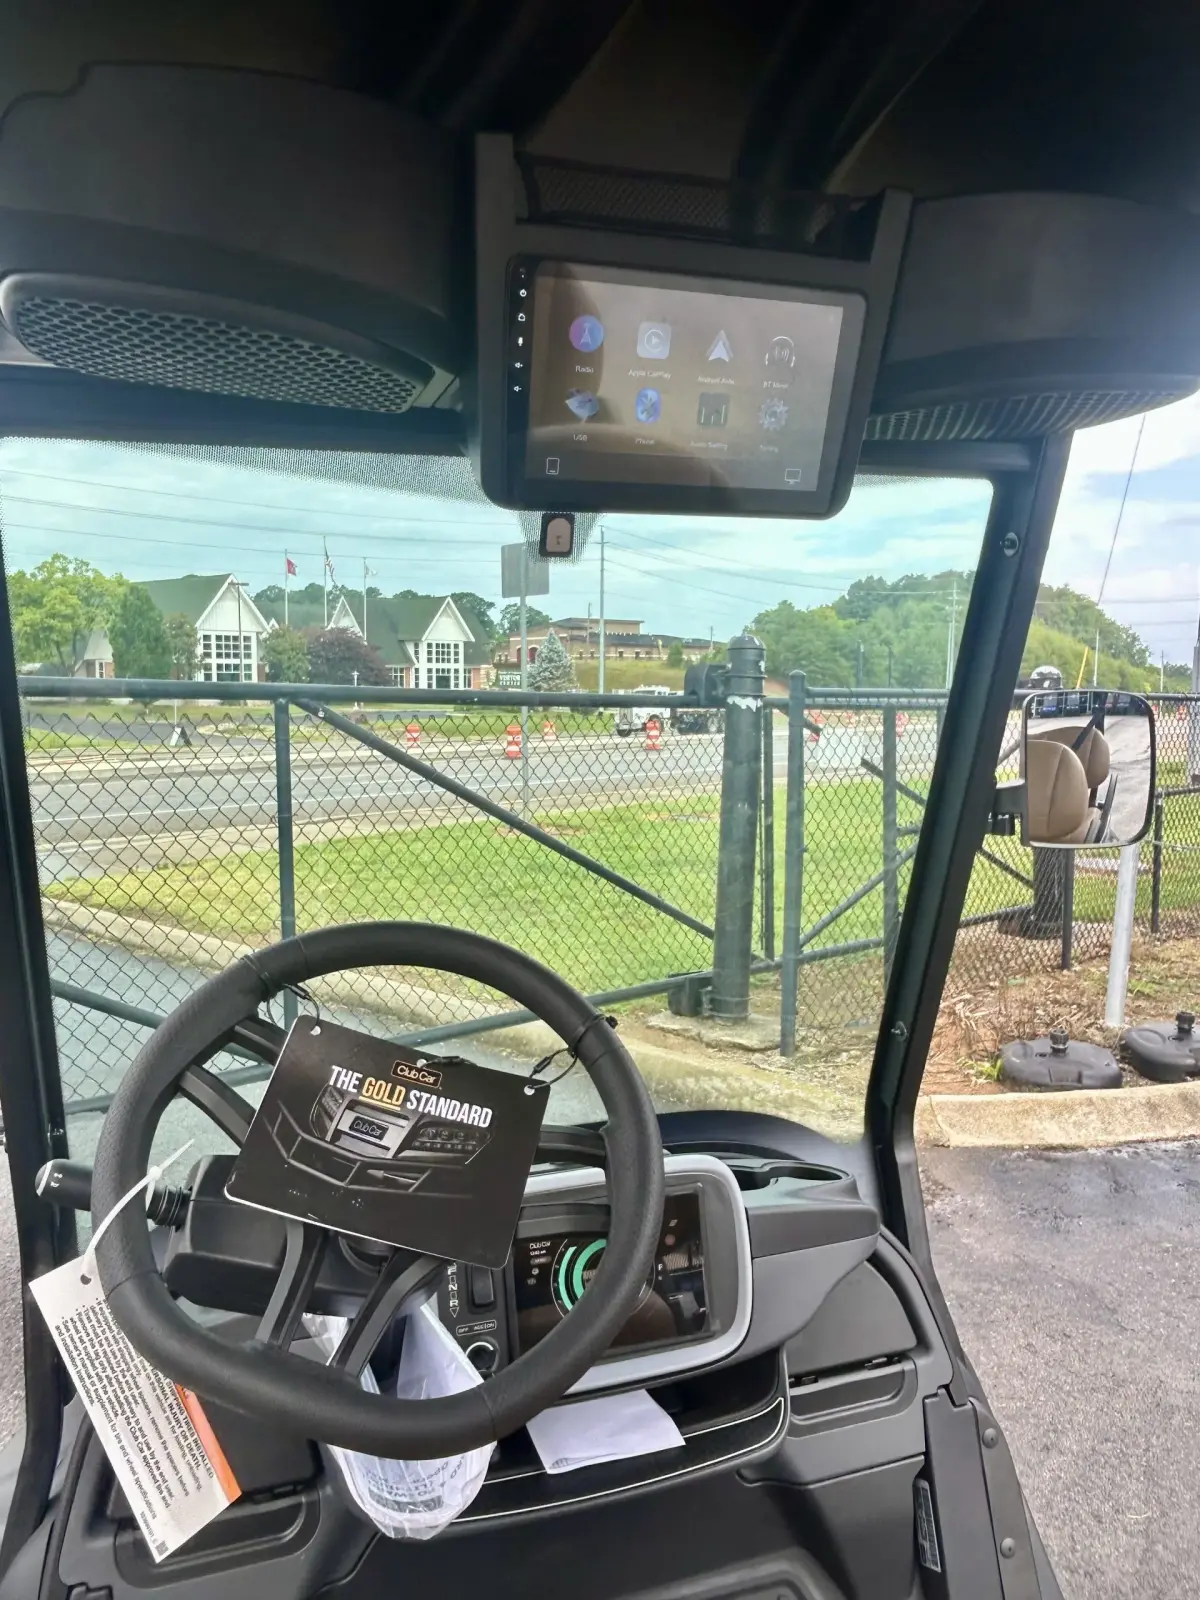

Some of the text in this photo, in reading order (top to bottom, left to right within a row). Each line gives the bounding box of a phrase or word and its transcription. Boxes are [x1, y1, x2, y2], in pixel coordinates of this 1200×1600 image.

[576, 365, 594, 373] Radio
[628, 369, 646, 377] Apple
[573, 434, 588, 442] USB
[397, 1065, 436, 1084] Club Car
[328, 1065, 493, 1128] THE GOLD STANDARD
[353, 1120, 383, 1137] Club Car
[449, 1283, 458, 1291] N
[449, 1299, 459, 1307] R
[82, 1308, 93, 1323] Tires
[61, 1319, 72, 1333] See
[75, 1311, 92, 1338] Remove
[89, 1322, 100, 1339] must
[97, 1305, 115, 1335] equipped
[111, 1333, 120, 1347] with
[67, 1332, 83, 1357] owner's
[87, 1336, 97, 1349] this
[96, 1339, 104, 1348] be
[103, 1335, 113, 1348] and
[91, 1348, 102, 1360] tag
[109, 1347, 118, 1360] use
[53, 1323, 97, 1407] and installation instructions.
[68, 1316, 120, 1419] wheel set supplied with the vehicle.
[78, 1356, 93, 1379] manual
[96, 1359, 108, 1374] only
[99, 1347, 117, 1375] replaced
[113, 1359, 122, 1368] by
[104, 1373, 115, 1388] after
[118, 1368, 127, 1379] the
[89, 1379, 96, 1387] or
[112, 1374, 126, 1394] before
[123, 1378, 133, 1391] end
[91, 1387, 114, 1424] supplement
[121, 1393, 137, 1419] delivery
[123, 1414, 133, 1426] the
[133, 1418, 141, 1426] to
[150, 1366, 202, 1470] ERSONAL INJURY OR DEATH.
[110, 1422, 118, 1432] for
[128, 1425, 140, 1442] Club
[137, 1425, 147, 1438] and
[169, 1425, 177, 1434] for
[135, 1440, 146, 1454] Car
[142, 1438, 152, 1451] use
[181, 1415, 196, 1438] TIRES
[191, 1437, 215, 1479] INSTALLED
[147, 1450, 157, 1460] by
[140, 1454, 159, 1484] approved
[153, 1459, 162, 1471] the
[158, 1470, 168, 1484] end
[160, 1494, 171, 1508] and
